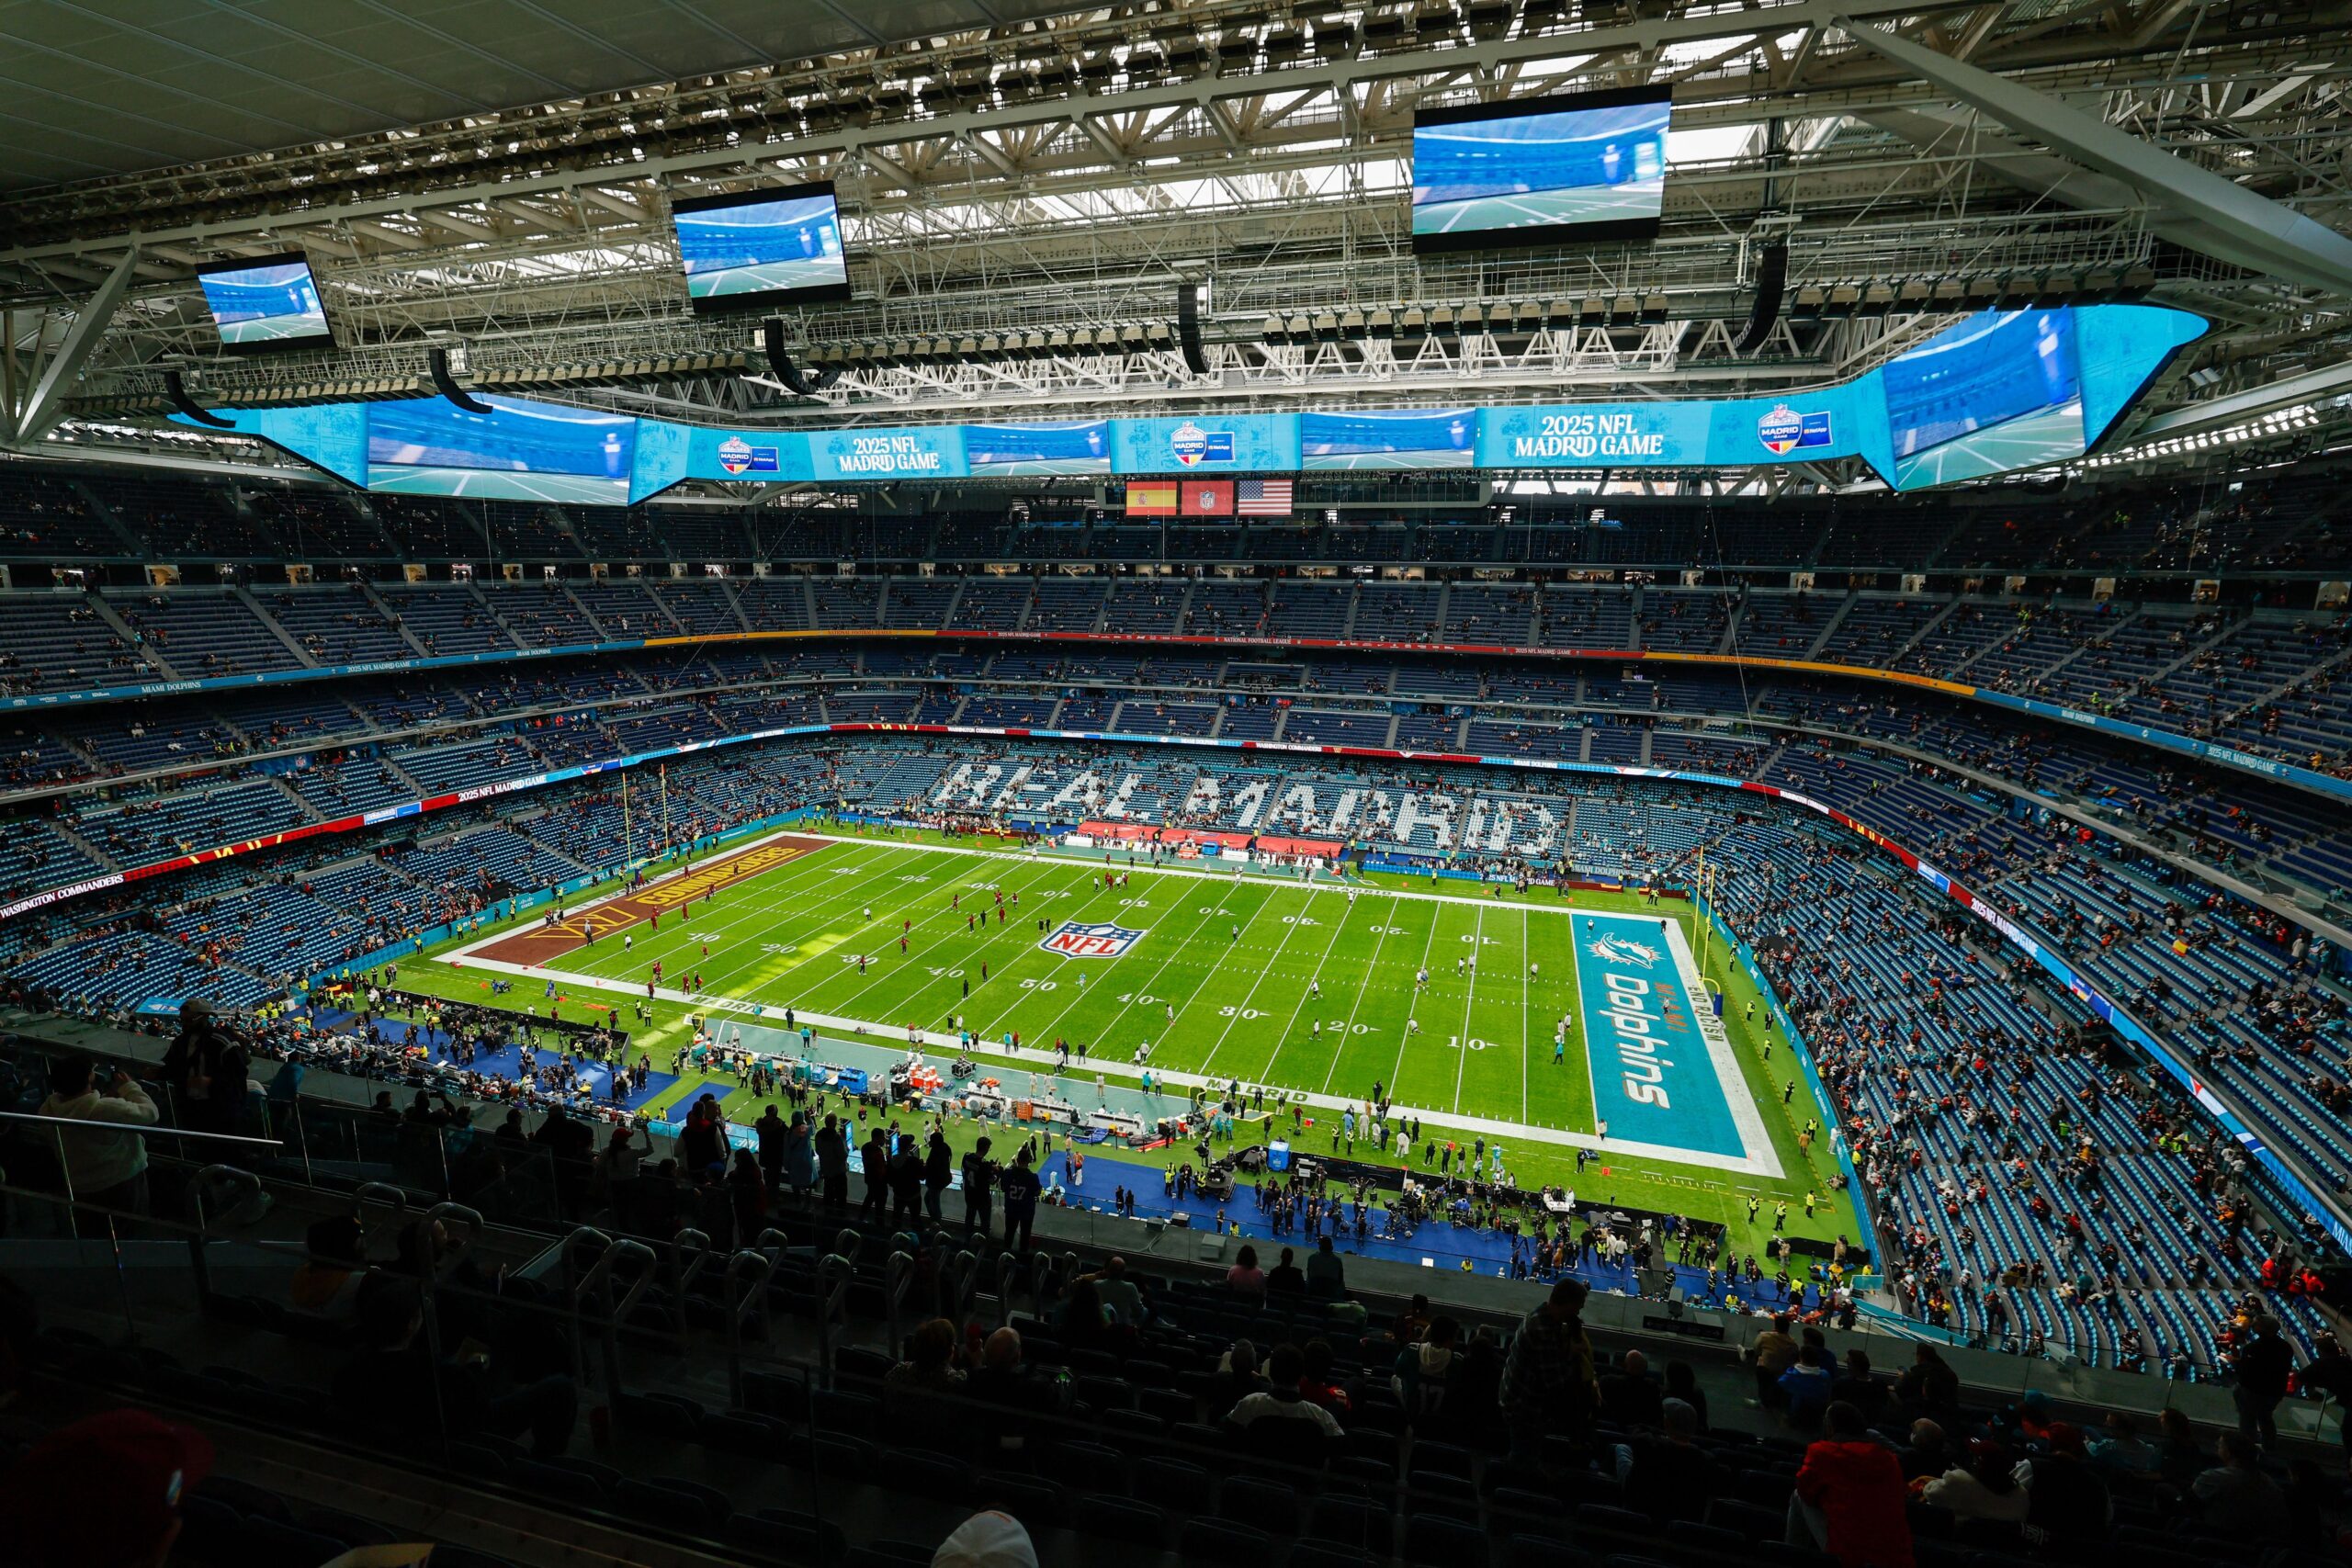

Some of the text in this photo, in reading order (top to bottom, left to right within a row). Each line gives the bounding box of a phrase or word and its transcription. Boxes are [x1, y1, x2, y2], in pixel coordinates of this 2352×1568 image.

[1542, 414, 1638, 436] 2025 NFL
[1761, 426, 1799, 436] MADRID
[853, 436, 920, 455] 2025 NFL
[1515, 434, 1664, 457] MADRID GAME
[839, 453, 940, 472] MADRID GAME
[372, 662, 396, 671] MADRID
[396, 660, 411, 669] GAME
[141, 682, 201, 694] MIAMI DOLPHINS
[1288, 744, 1322, 752] COMMANDERS
[2207, 746, 2278, 773] 2025 NFL MADRID GAME
[458, 774, 547, 802] 2025 NFL MADRID GAME
[935, 762, 1555, 852] REAL MADRID
[0, 874, 124, 919] WASHINGTON COMMANDERS
[1328, 886, 1391, 896] MADRID
[521, 901, 534, 909] cisco
[1970, 897, 2039, 957] 2025 NFL MADRID GAME
[761, 943, 797, 953] 20
[1049, 933, 1116, 955] NFL
[840, 954, 878, 965] 30
[929, 967, 965, 978] 40
[1019, 978, 1057, 991] 50
[1117, 993, 1154, 1005] 40
[1218, 1006, 1258, 1020] 30
[1688, 987, 1725, 1043] END RACISM
[1327, 1021, 1368, 1034] 20
[1447, 1035, 1486, 1050] 10
[1598, 972, 1675, 1110] Dolphins
[1010, 1184, 1027, 1201] 27
[1419, 1382, 1446, 1416] 17
